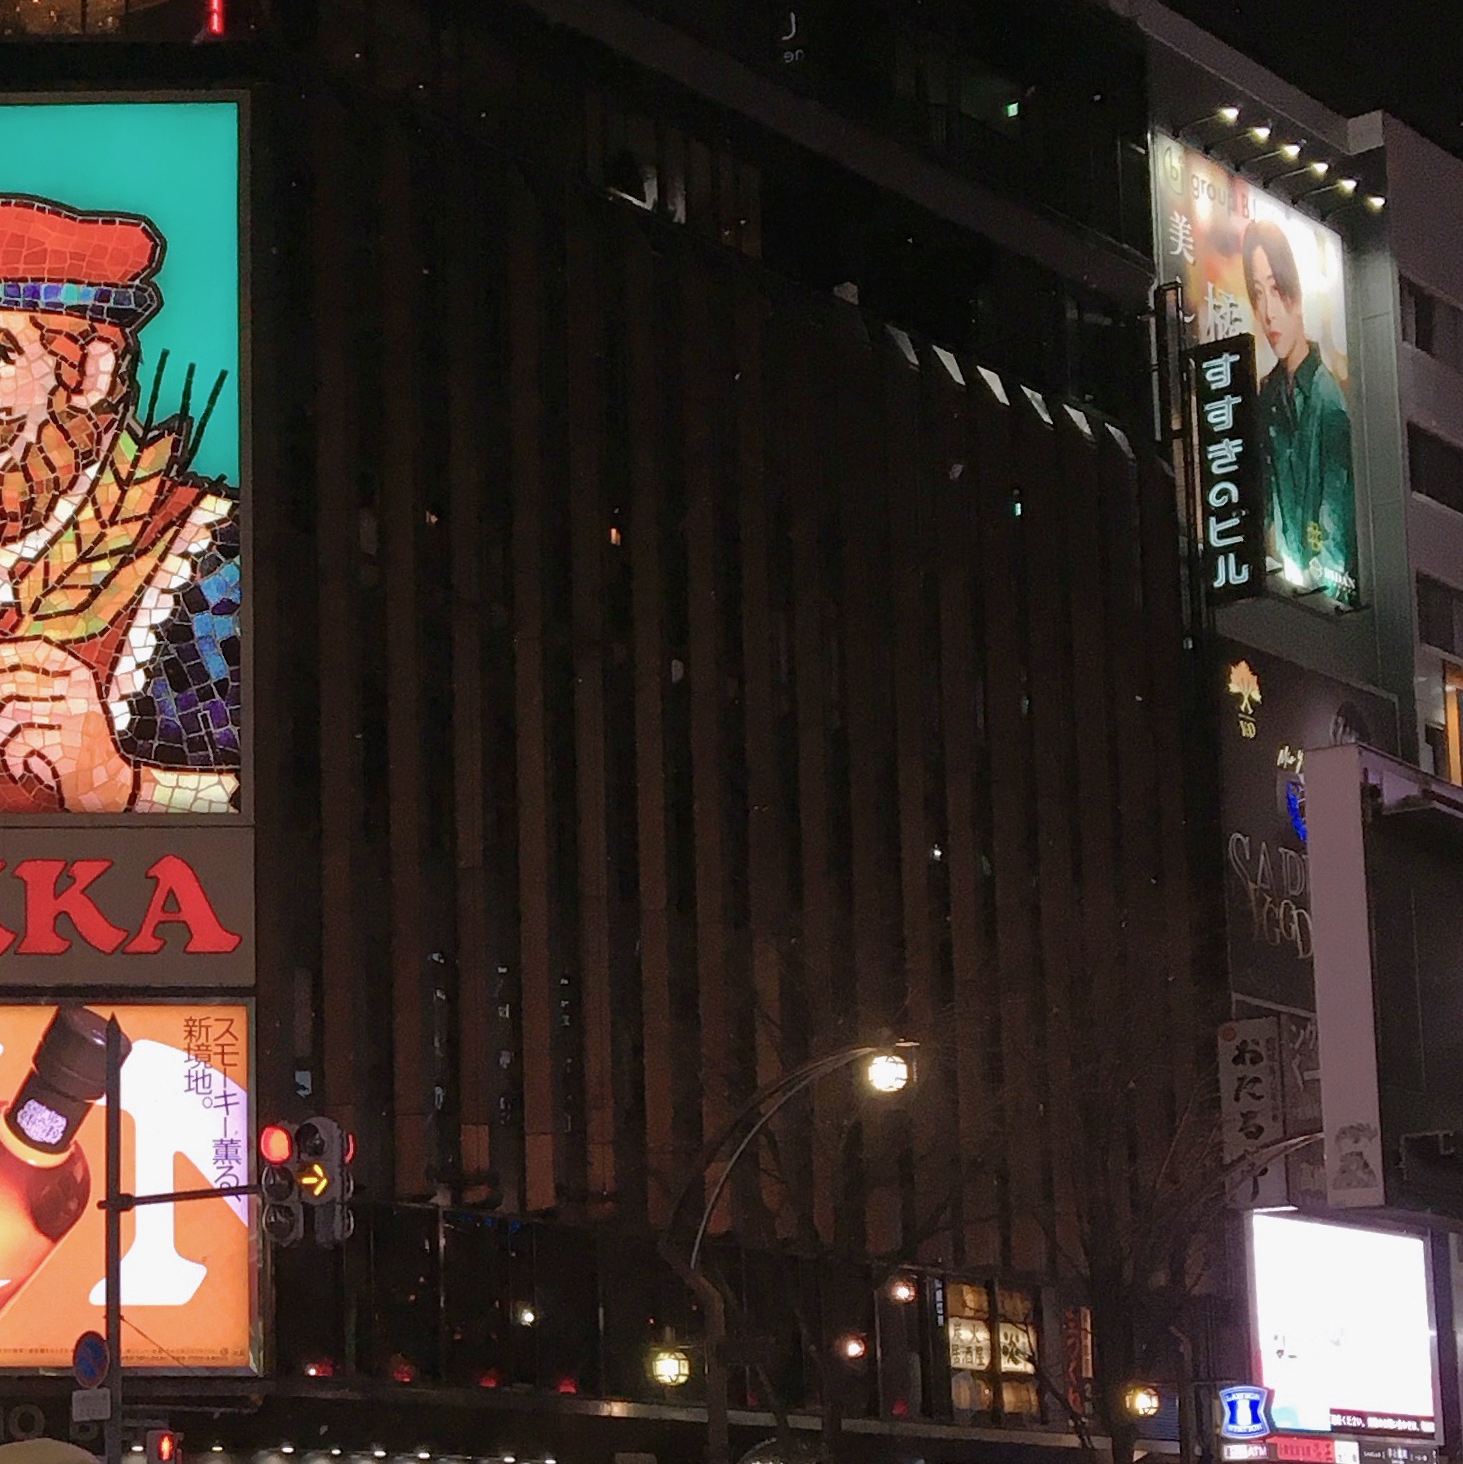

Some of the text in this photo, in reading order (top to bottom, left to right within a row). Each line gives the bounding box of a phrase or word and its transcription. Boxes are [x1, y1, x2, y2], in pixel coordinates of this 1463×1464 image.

[1202, 352, 1250, 590] すすきのビル
[183, 1016, 214, 1109] 新境地。
[951, 1344, 986, 1367] 居酒屋
